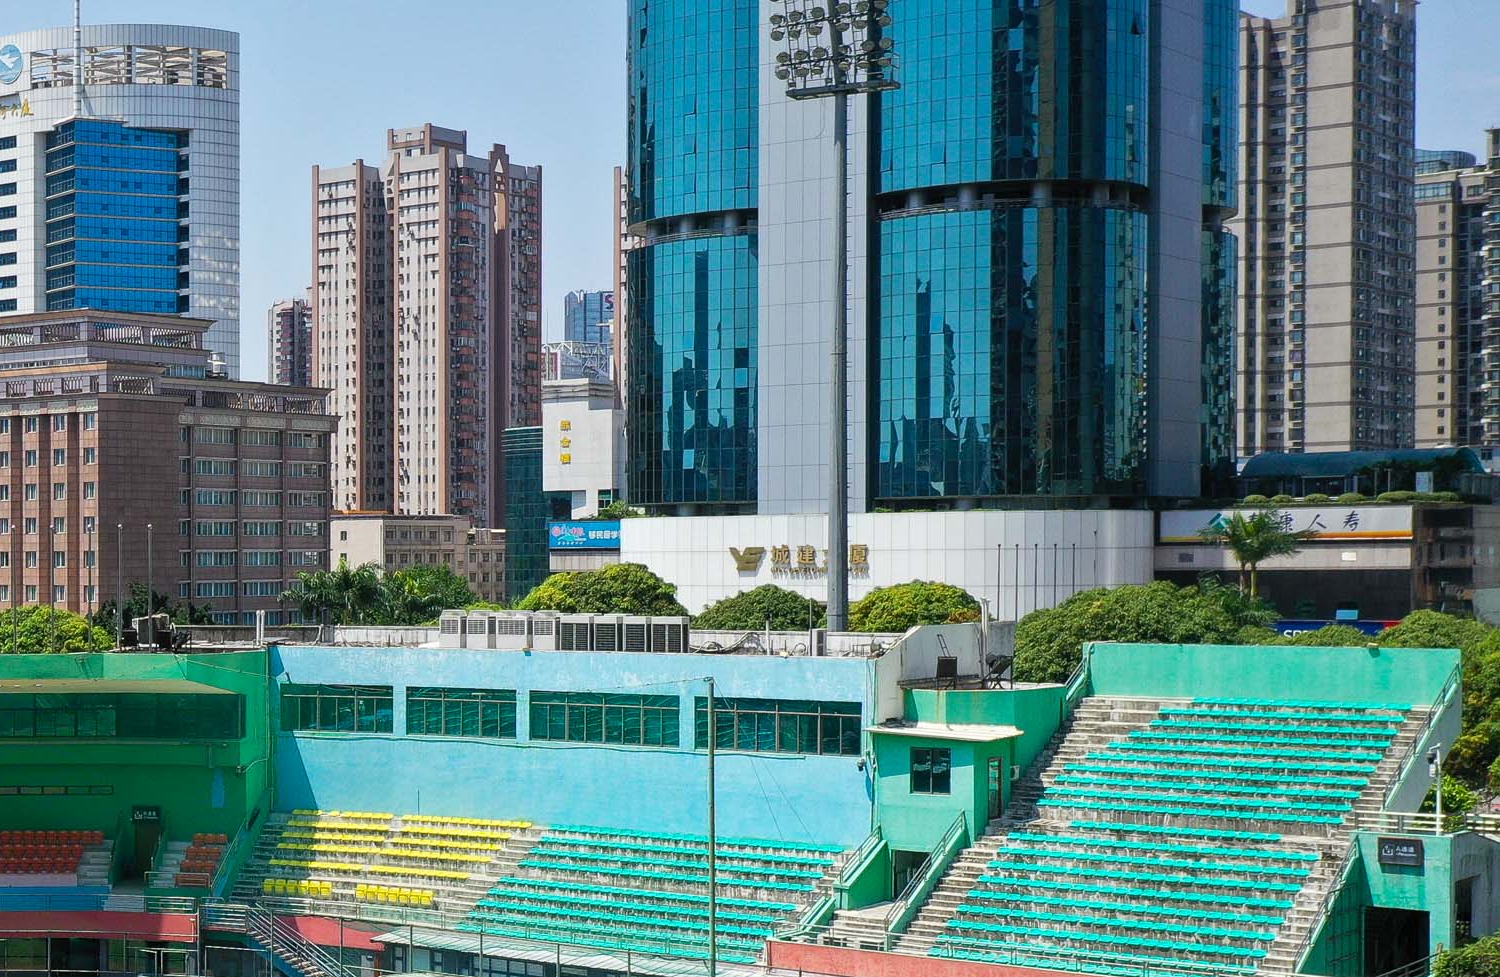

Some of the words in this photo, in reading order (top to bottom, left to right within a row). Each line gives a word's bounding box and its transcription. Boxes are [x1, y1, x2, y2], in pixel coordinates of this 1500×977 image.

[1248, 510, 1360, 532] 康人寿
[771, 544, 869, 564] 城建厦
